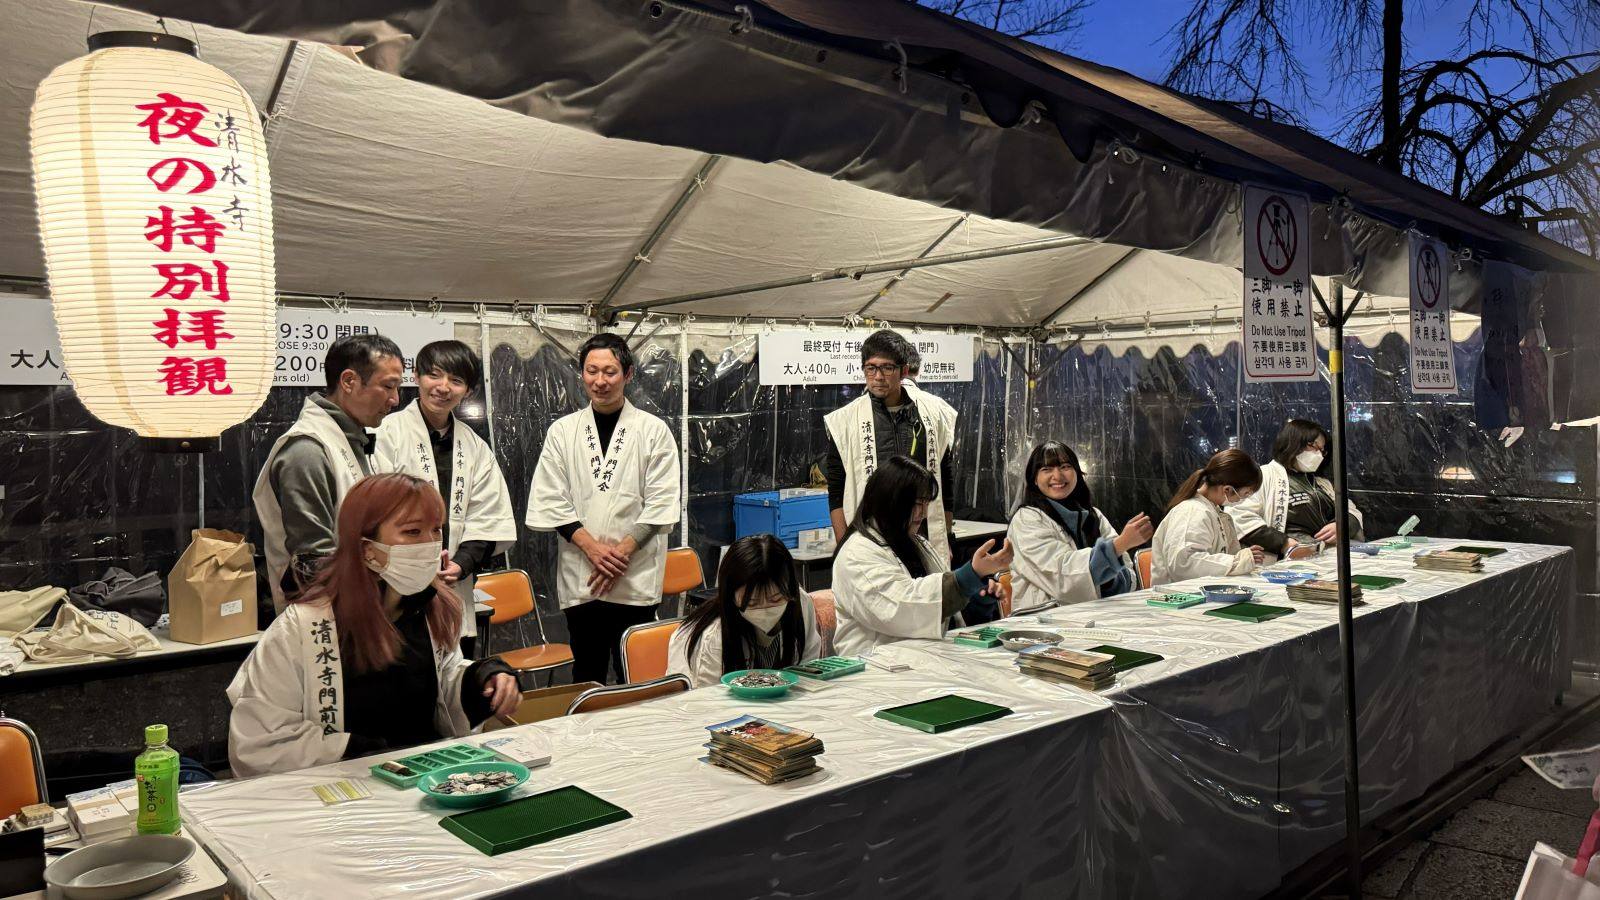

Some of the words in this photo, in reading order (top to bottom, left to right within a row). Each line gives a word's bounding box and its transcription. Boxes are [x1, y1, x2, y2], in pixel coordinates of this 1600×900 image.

[214, 108, 249, 231] 清水寺
[135, 92, 236, 397] 夜の特別拝観
[1251, 297, 1305, 318] 使用禁止
[280, 323, 328, 340] 9:30
[1251, 324, 1260, 336] Do
[1261, 325, 1273, 336] Not
[1274, 325, 1286, 337] Use
[1287, 325, 1306, 339] Tripod
[277, 341, 299, 350] OSE
[1254, 356, 1275, 369] 삼각대
[1278, 356, 1292, 369] 사용
[1295, 356, 1308, 369] 금지
